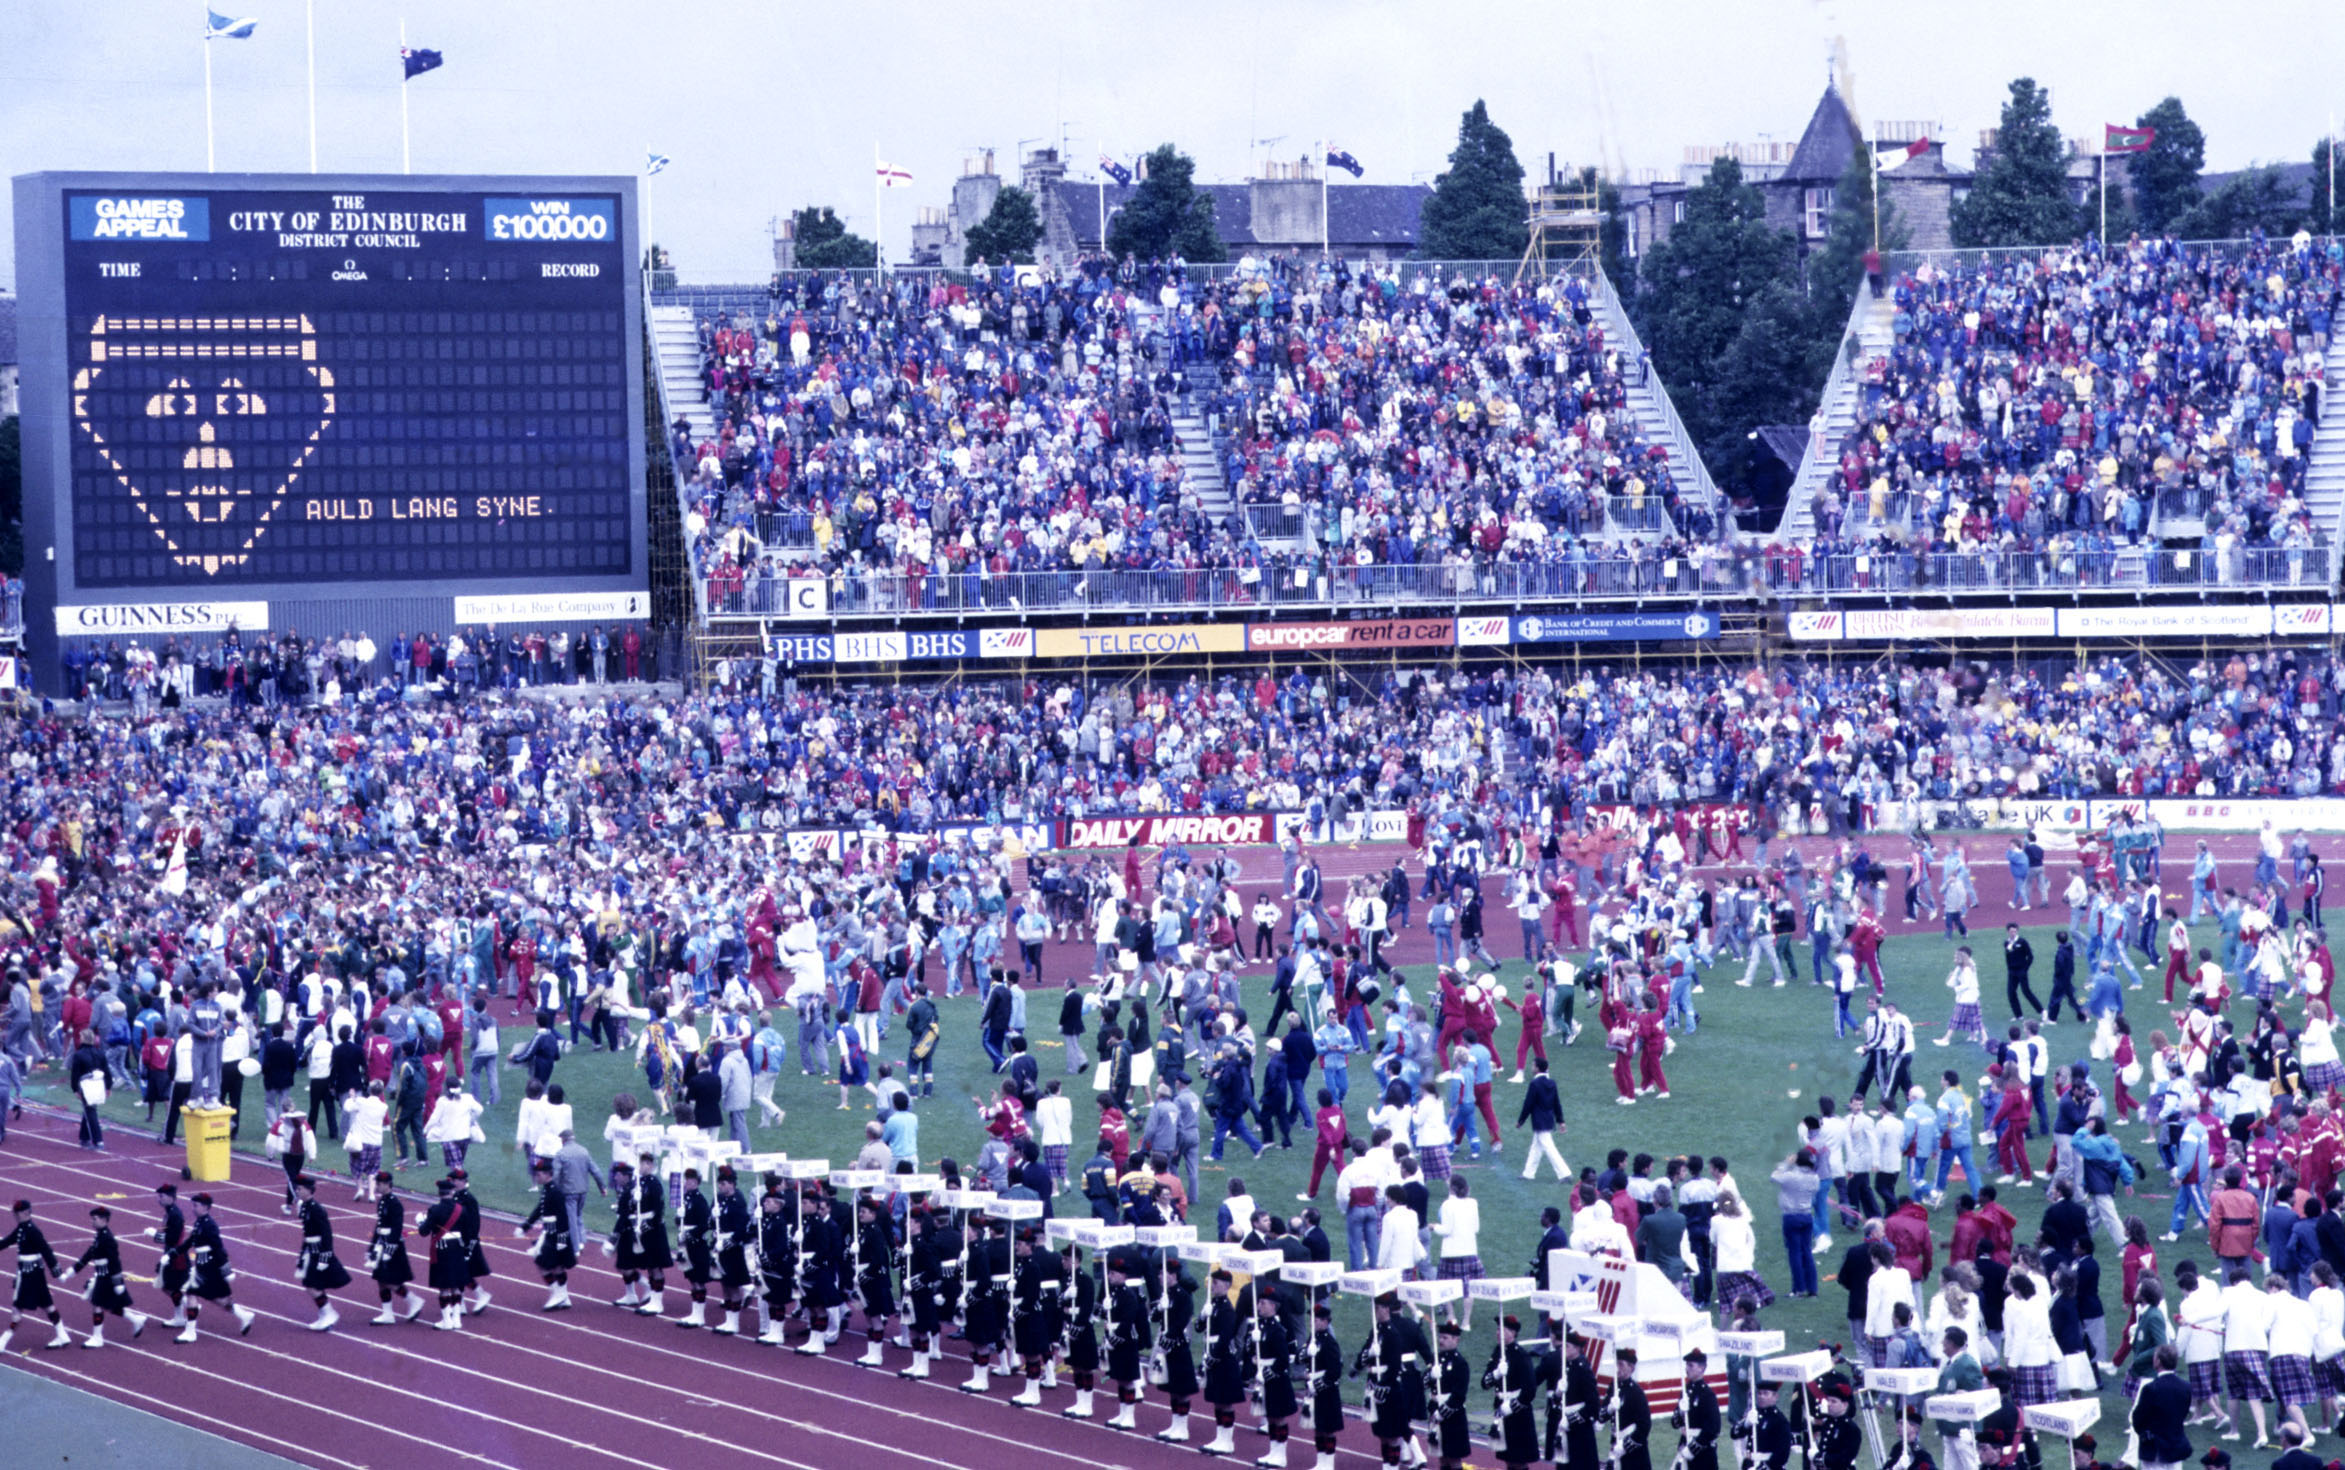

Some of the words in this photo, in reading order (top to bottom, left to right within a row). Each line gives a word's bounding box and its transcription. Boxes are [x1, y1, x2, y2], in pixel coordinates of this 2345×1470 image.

[95, 198, 185, 218] GAMES
[332, 195, 365, 209] THE
[530, 201, 570, 214] WIN
[94, 218, 188, 238] APPEAL
[229, 212, 283, 231] CITY
[291, 212, 321, 231] OF
[330, 212, 467, 232] EDINBURGH
[493, 214, 607, 240] £100,000
[278, 233, 349, 248] DISTRICT
[354, 234, 421, 248] COUNCIL
[99, 262, 141, 277] TIME
[331, 271, 368, 281] OMEGA
[541, 263, 600, 278] RECORD
[306, 498, 373, 520] AULD
[392, 497, 458, 519] LANG
[476, 496, 555, 518] SYNE.
[798, 587, 816, 609] C
[78, 604, 212, 628] GUINNESS
[463, 604, 486, 616] The
[490, 602, 508, 615] De
[511, 602, 526, 614] La
[531, 601, 554, 614] Rue
[558, 599, 616, 616] Company
[1544, 618, 1569, 629] BANK
[1582, 617, 1614, 628] CREDIT
[1615, 618, 1634, 627] AND
[1634, 616, 1682, 627] COMMERCE
[2119, 616, 2148, 627] Royal
[2152, 615, 2178, 625] Bank
[2200, 615, 2248, 625] Scotland
[1250, 626, 1348, 648] europcar
[1350, 624, 1393, 641] rent
[1397, 624, 1410, 639] a
[1415, 623, 1451, 639] car
[1544, 628, 1609, 637] INTERNATIONAL
[846, 636, 898, 658] BHS
[911, 633, 967, 657] BHS
[1079, 632, 1201, 654] TELECOM
[2025, 807, 2055, 823] UK
[1071, 821, 1146, 849] DAILY
[1148, 815, 1263, 844] MIRROR
[1718, 1337, 1753, 1351] SWAZILAND
[1875, 1375, 1897, 1388] WALES
[2030, 1412, 2070, 1432] SCOTLAND
